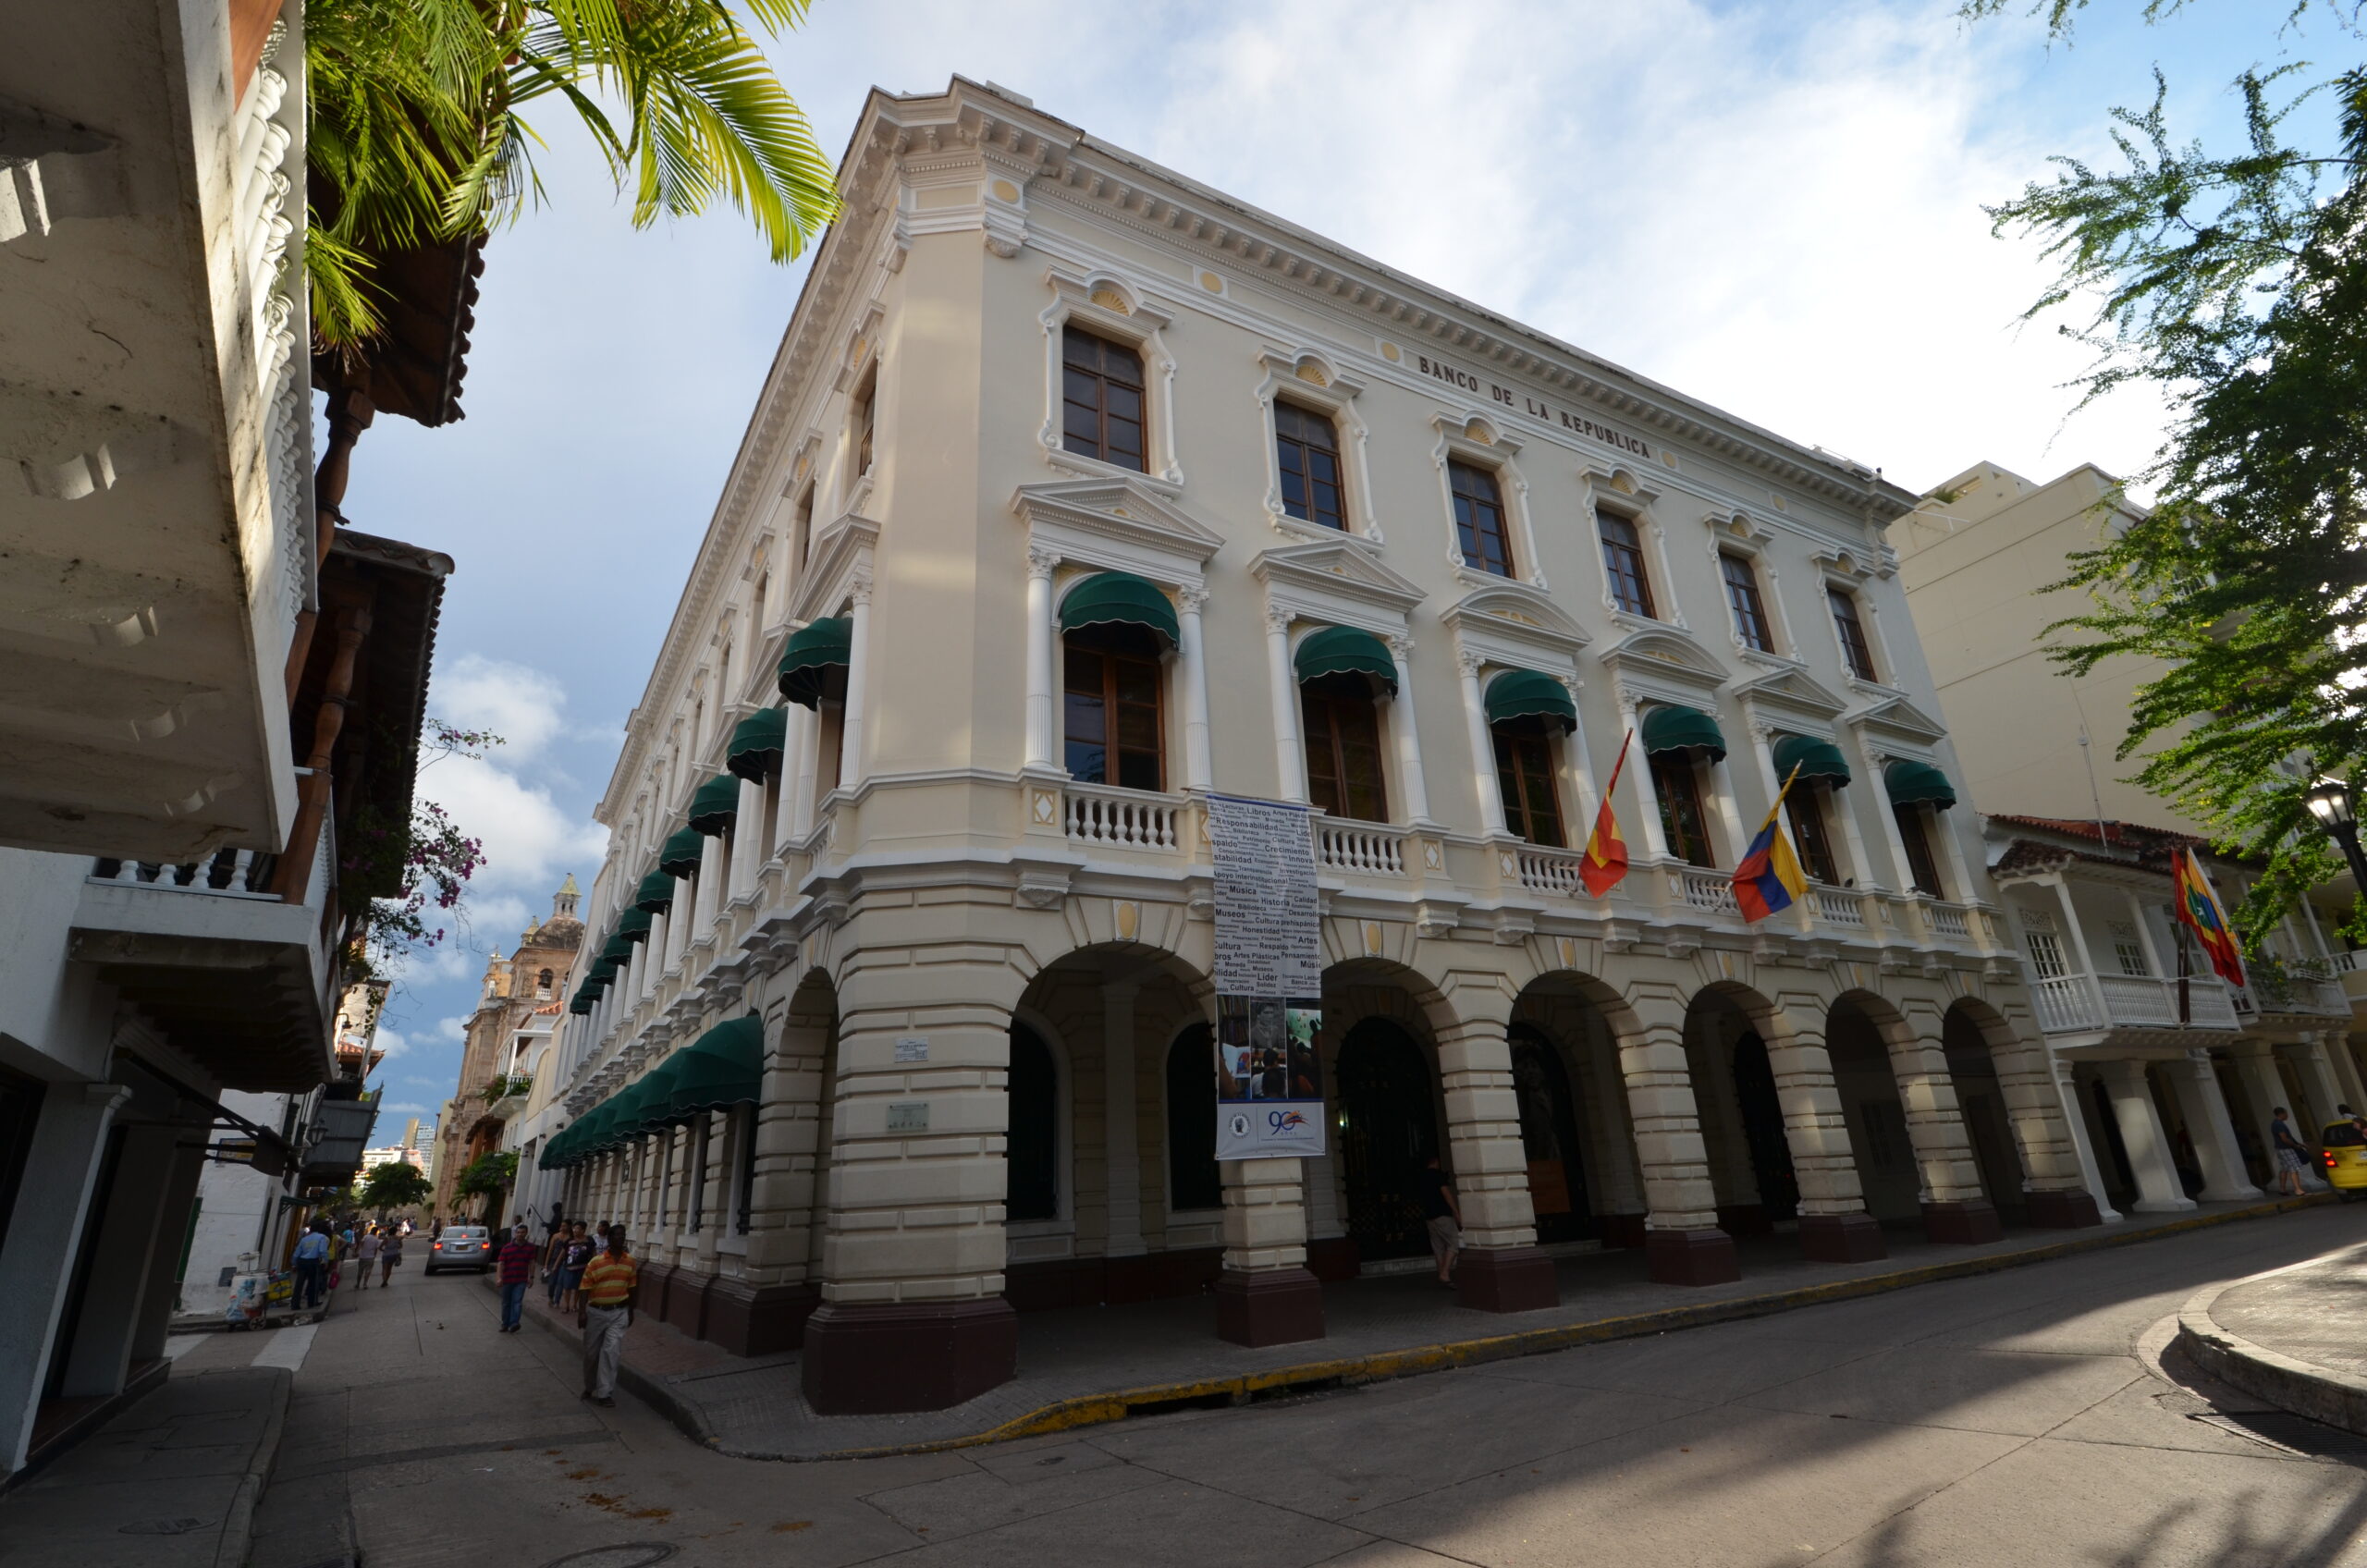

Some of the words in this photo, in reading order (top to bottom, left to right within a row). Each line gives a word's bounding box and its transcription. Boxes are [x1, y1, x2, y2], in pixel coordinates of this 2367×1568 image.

[1419, 356, 1478, 392] BANCO
[1491, 385, 1514, 406] DE
[1527, 398, 1549, 420] LA
[1561, 411, 1650, 459] REPUBLICA
[1246, 806, 1270, 816] Libros
[1216, 816, 1278, 831] Responsabilidad
[1272, 836, 1294, 844] Cultura
[1264, 844, 1309, 856] Crecimiento
[1214, 854, 1252, 864] stabilidad
[1214, 871, 1233, 879] Apoyo
[1235, 873, 1288, 884] interinstitucional
[1229, 885, 1257, 895] Música
[1261, 898, 1290, 906] Historia
[1294, 895, 1317, 903] Calidad
[1237, 903, 1267, 912] Biblioteca
[1215, 908, 1245, 918] Museos
[1255, 916, 1280, 925] Cultura
[1242, 925, 1280, 935] Honestidad
[1298, 936, 1318, 944] Artes
[1258, 942, 1289, 950] Respaldo
[1230, 984, 1254, 992] Cultura
[1269, 1110, 1295, 1135] 90
